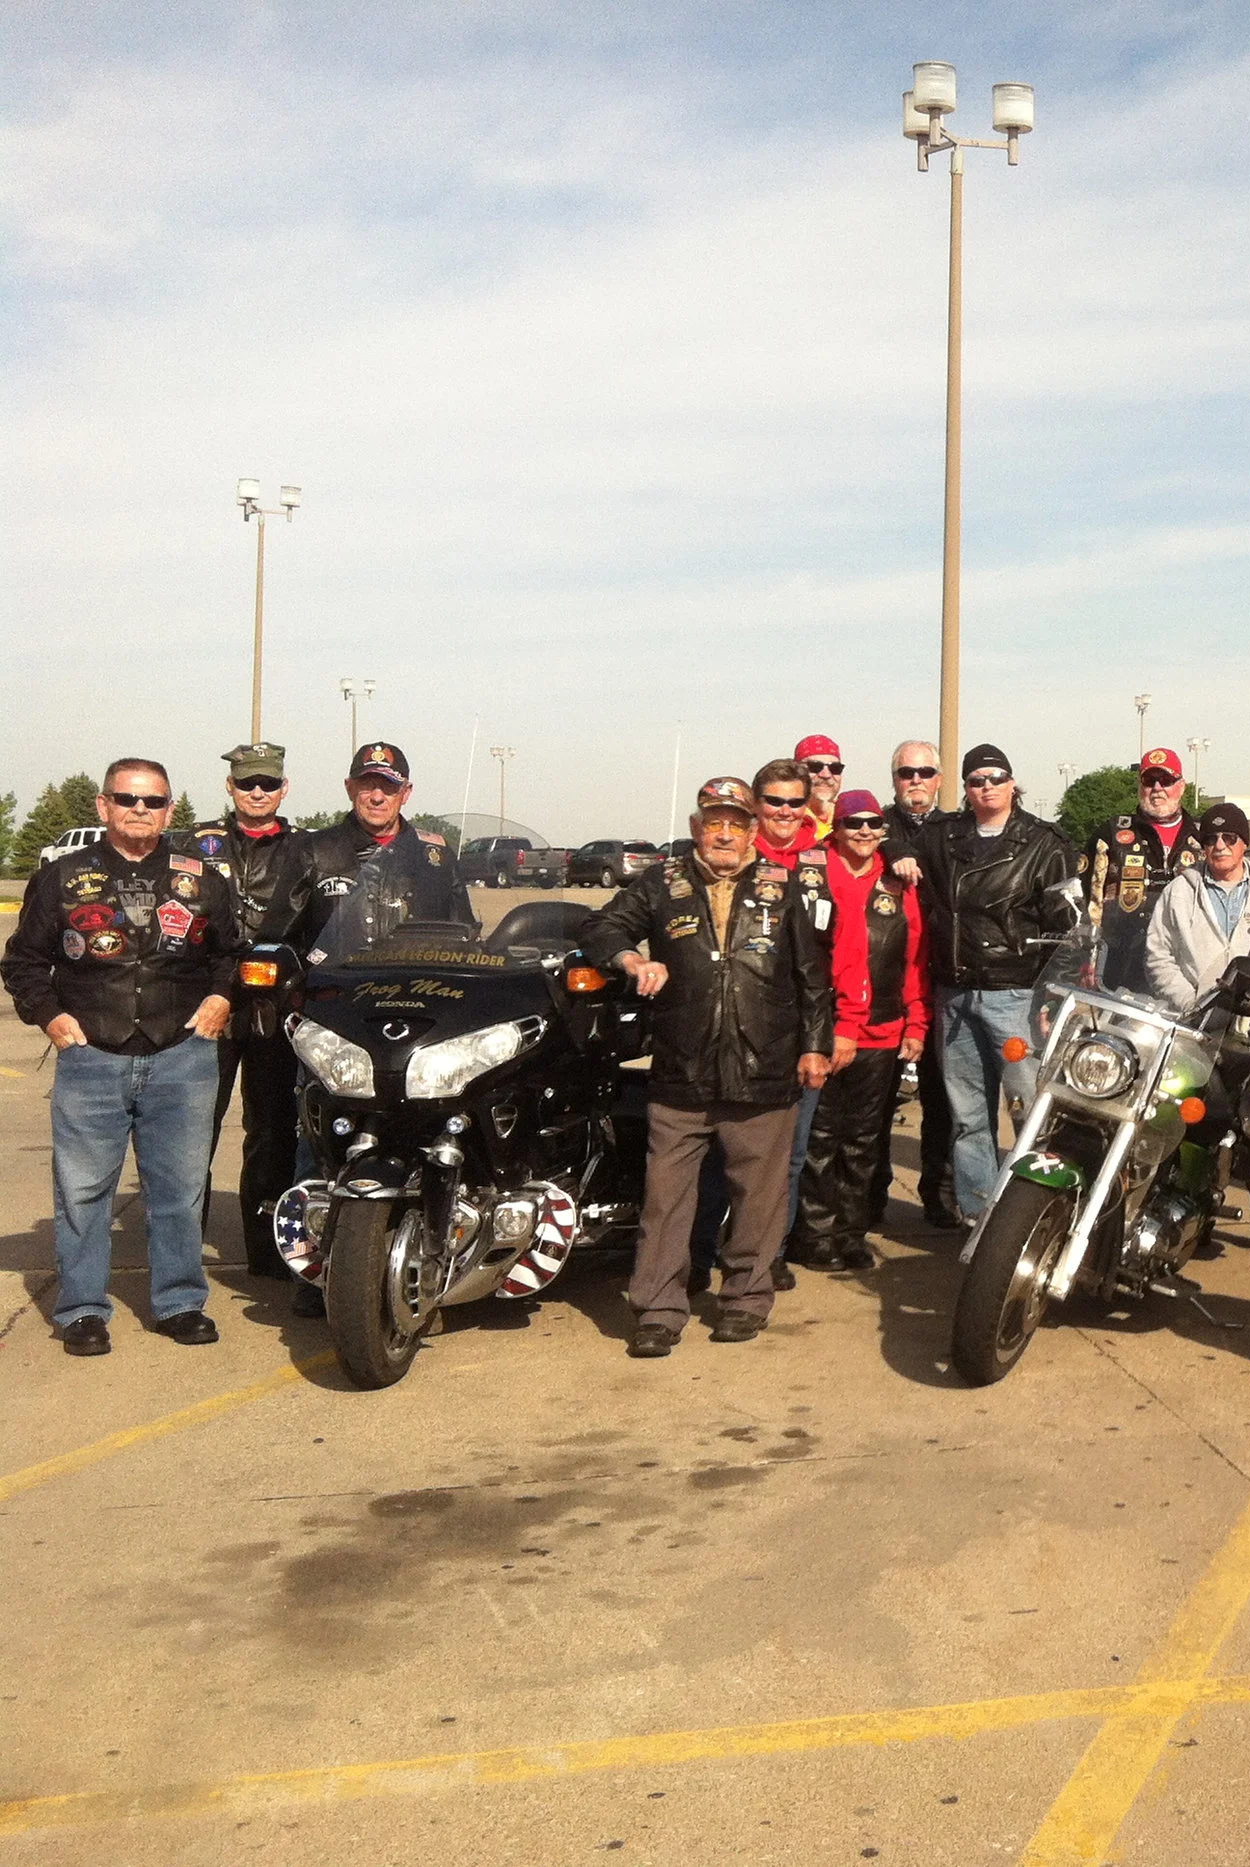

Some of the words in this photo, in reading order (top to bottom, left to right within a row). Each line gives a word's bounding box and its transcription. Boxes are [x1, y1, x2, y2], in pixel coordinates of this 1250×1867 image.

[115, 878, 156, 891] LEY
[665, 914, 700, 932] KOREA
[409, 950, 463, 964] LEGION
[465, 953, 506, 967] RIDER
[353, 981, 401, 1001] Frog
[409, 979, 465, 999] Man
[375, 1000, 426, 1009] HONDA
